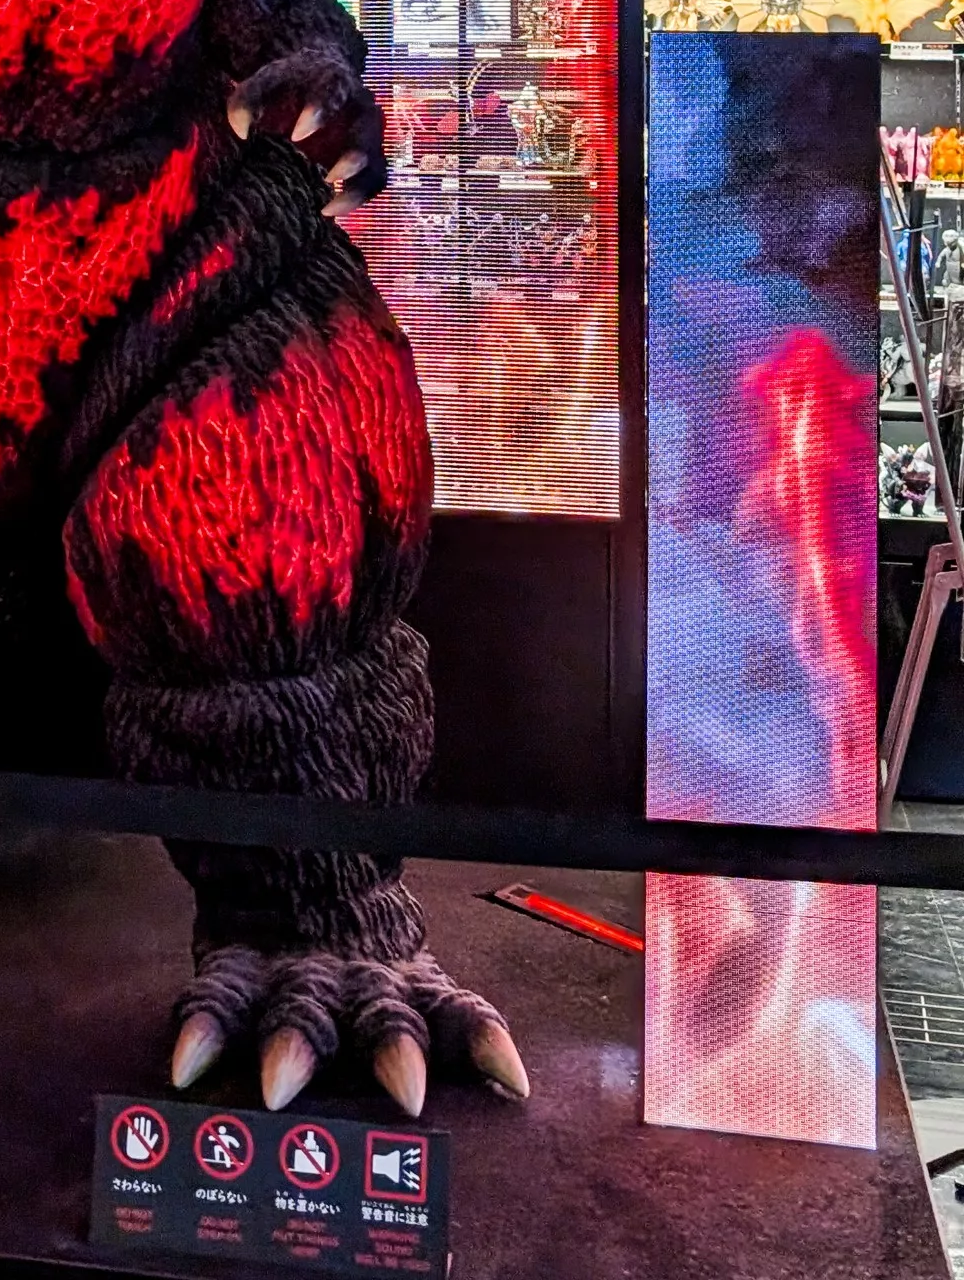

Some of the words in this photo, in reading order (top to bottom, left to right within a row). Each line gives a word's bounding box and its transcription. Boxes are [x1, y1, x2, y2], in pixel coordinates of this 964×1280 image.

[112, 1178, 163, 1194] さわらない
[195, 1188, 248, 1204] のぼらない
[275, 1196, 341, 1215] 物を置かない
[361, 1206, 429, 1227] 警告音に注意
